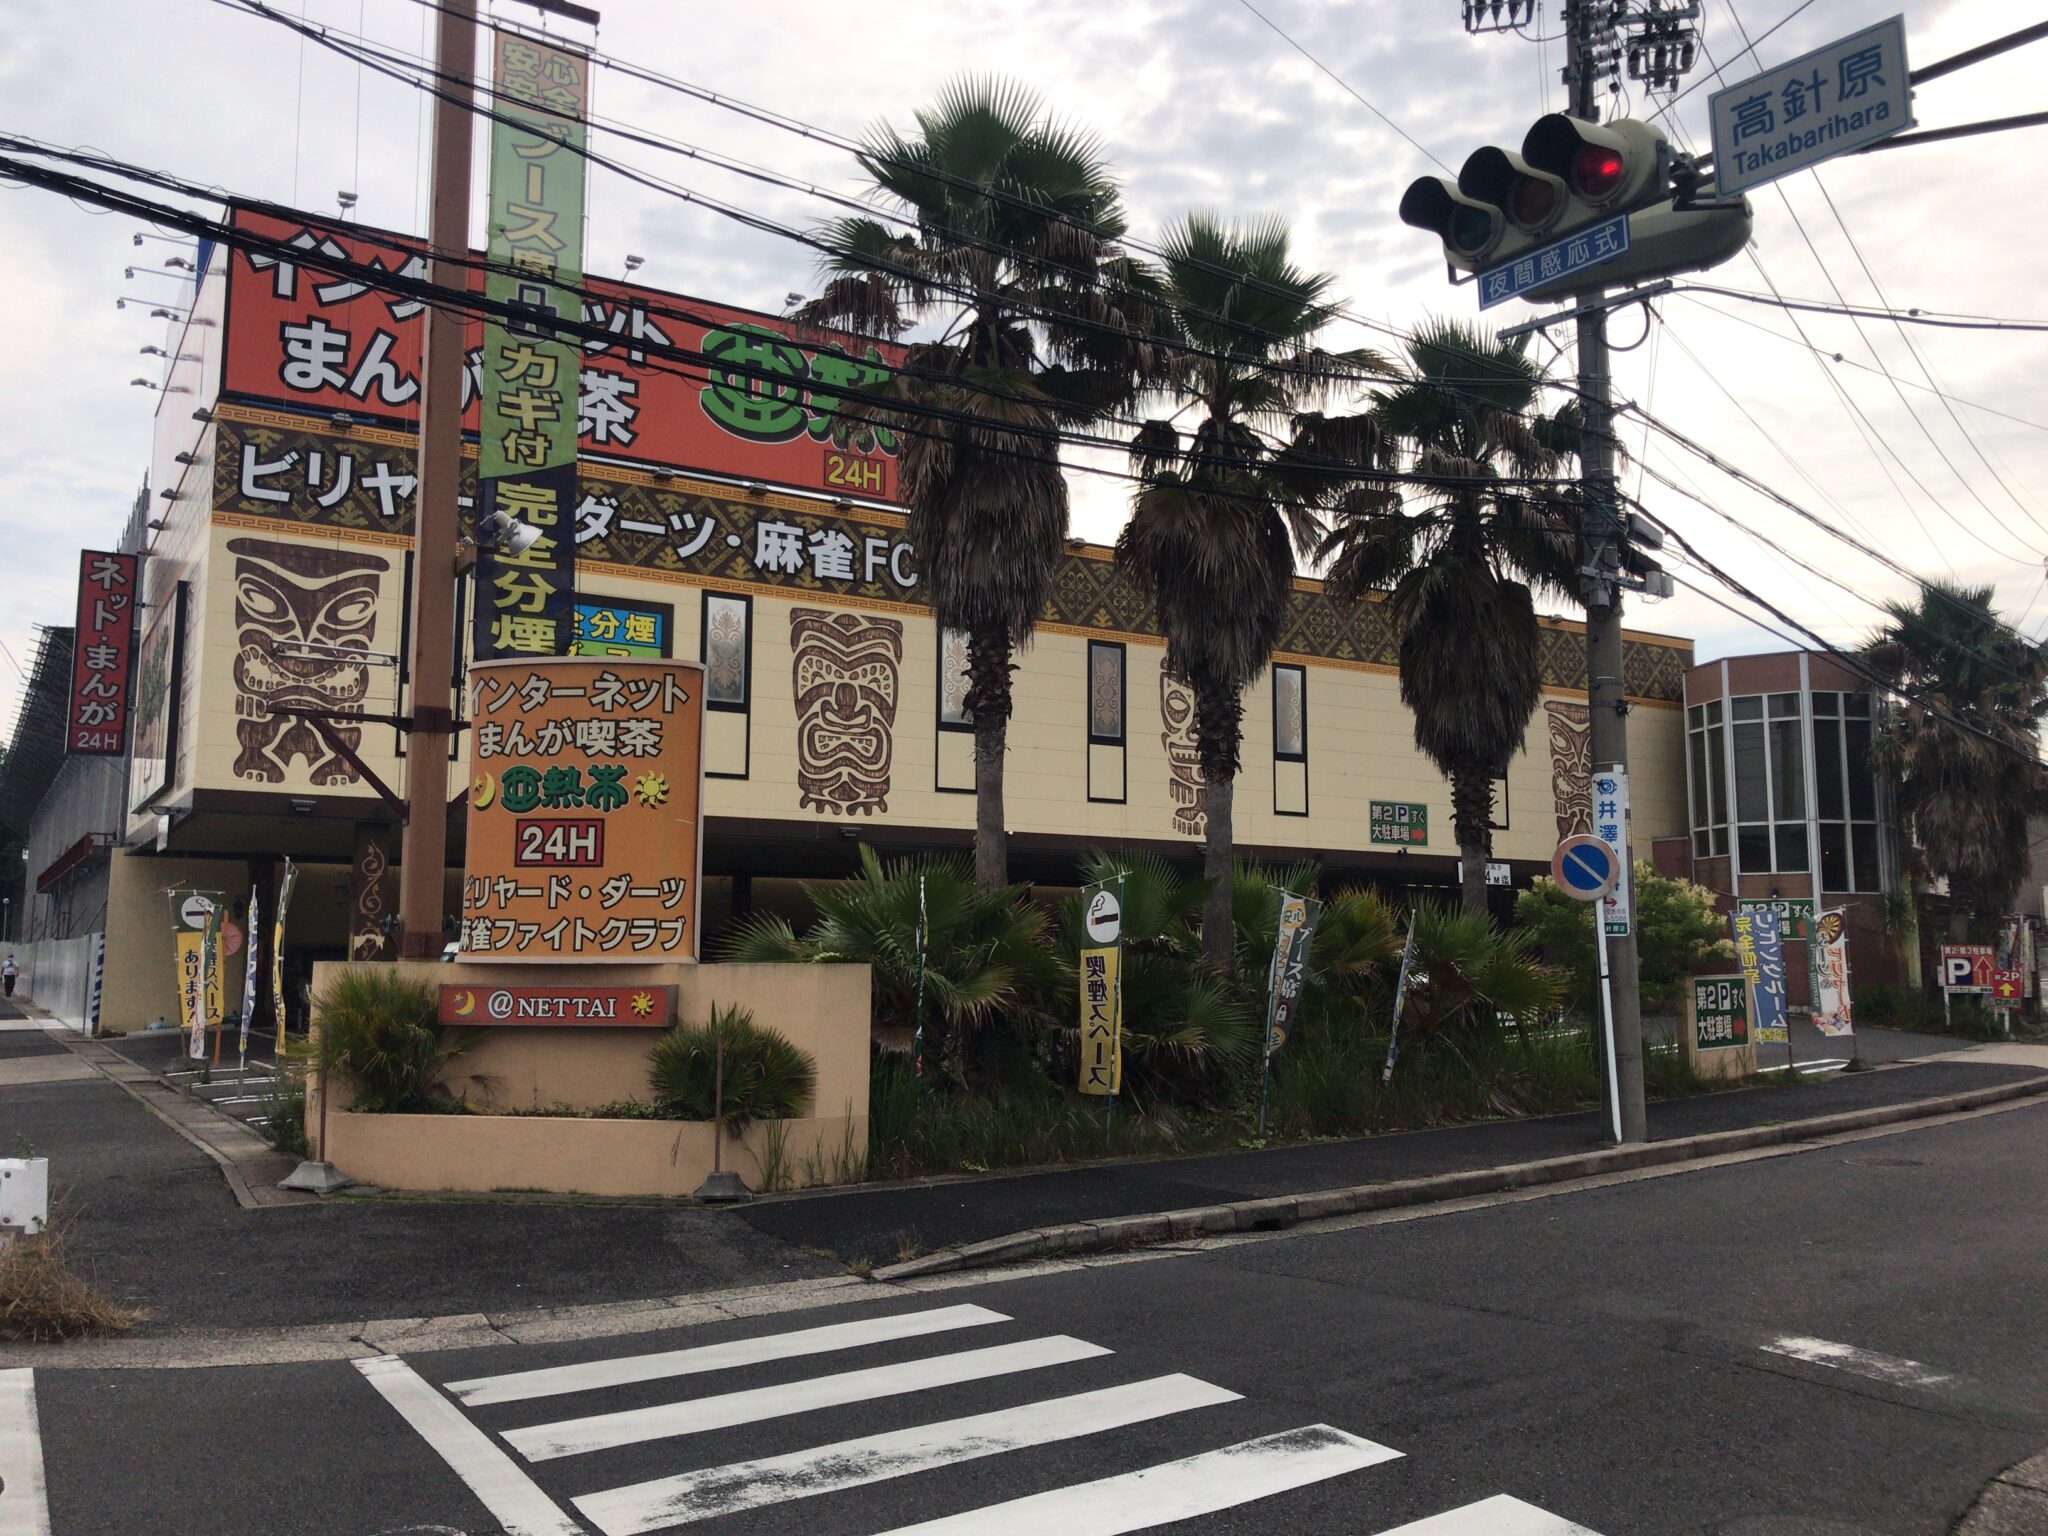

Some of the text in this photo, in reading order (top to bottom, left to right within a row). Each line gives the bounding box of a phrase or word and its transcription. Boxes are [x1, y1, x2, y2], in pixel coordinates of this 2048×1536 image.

[503, 42, 580, 85] 安心
[1730, 43, 1886, 147] 高針原
[1732, 101, 1889, 175] Takabarihara
[1488, 225, 1618, 299] 夜間感応式
[828, 455, 882, 491] 24H
[78, 557, 128, 726] ネット・まんが
[78, 731, 117, 749] 24H
[478, 718, 663, 758] まんが喫茶
[520, 825, 597, 862] 24H
[1372, 824, 1409, 841] 大駐車場
[1947, 958, 1971, 984] P
[488, 990, 616, 1019] @NETTAI
[1698, 1015, 1732, 1041] 大駐車場
